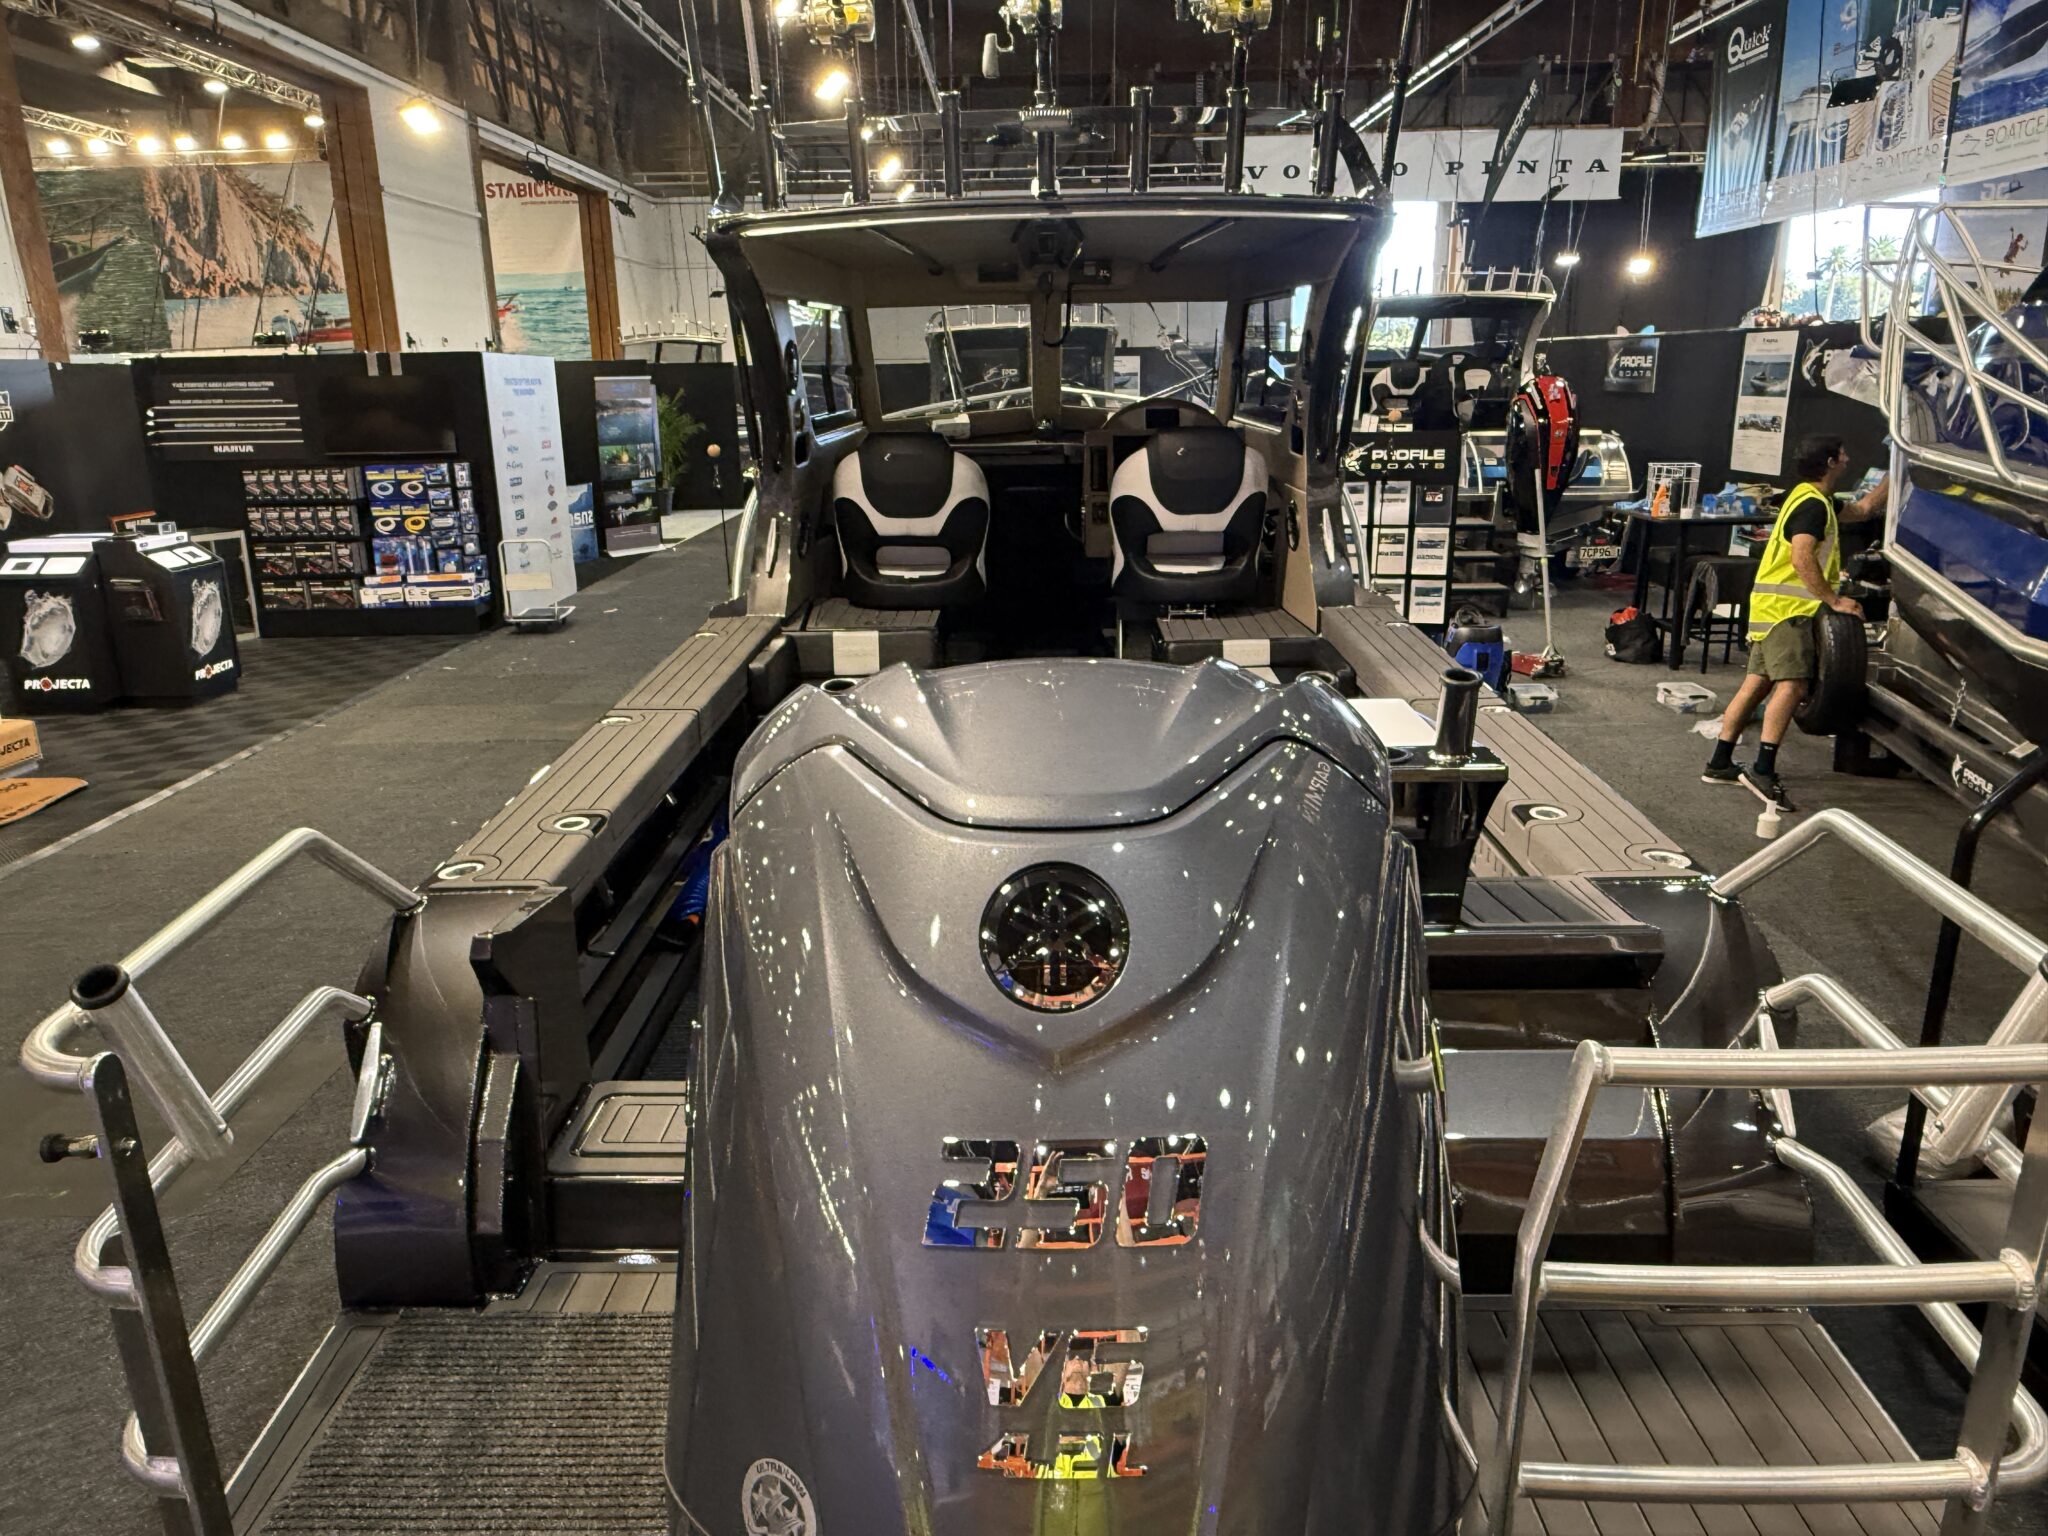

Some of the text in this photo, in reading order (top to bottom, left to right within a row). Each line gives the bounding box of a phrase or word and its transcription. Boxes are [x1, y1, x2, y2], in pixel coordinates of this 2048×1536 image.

[1728, 25, 1769, 65] Quick
[1985, 115, 2048, 148] BOATGE
[1244, 162, 1408, 180] VOO
[485, 182, 573, 198] STABICRA
[1619, 355, 1653, 367] PROFILE
[213, 445, 254, 453] NARVA
[195, 659, 234, 681] PROJECTA
[24, 677, 91, 692] PROJECTA
[1963, 768, 1994, 794] PROFILE
[921, 1133, 1208, 1249] 250
[974, 1326, 1149, 1409] V6
